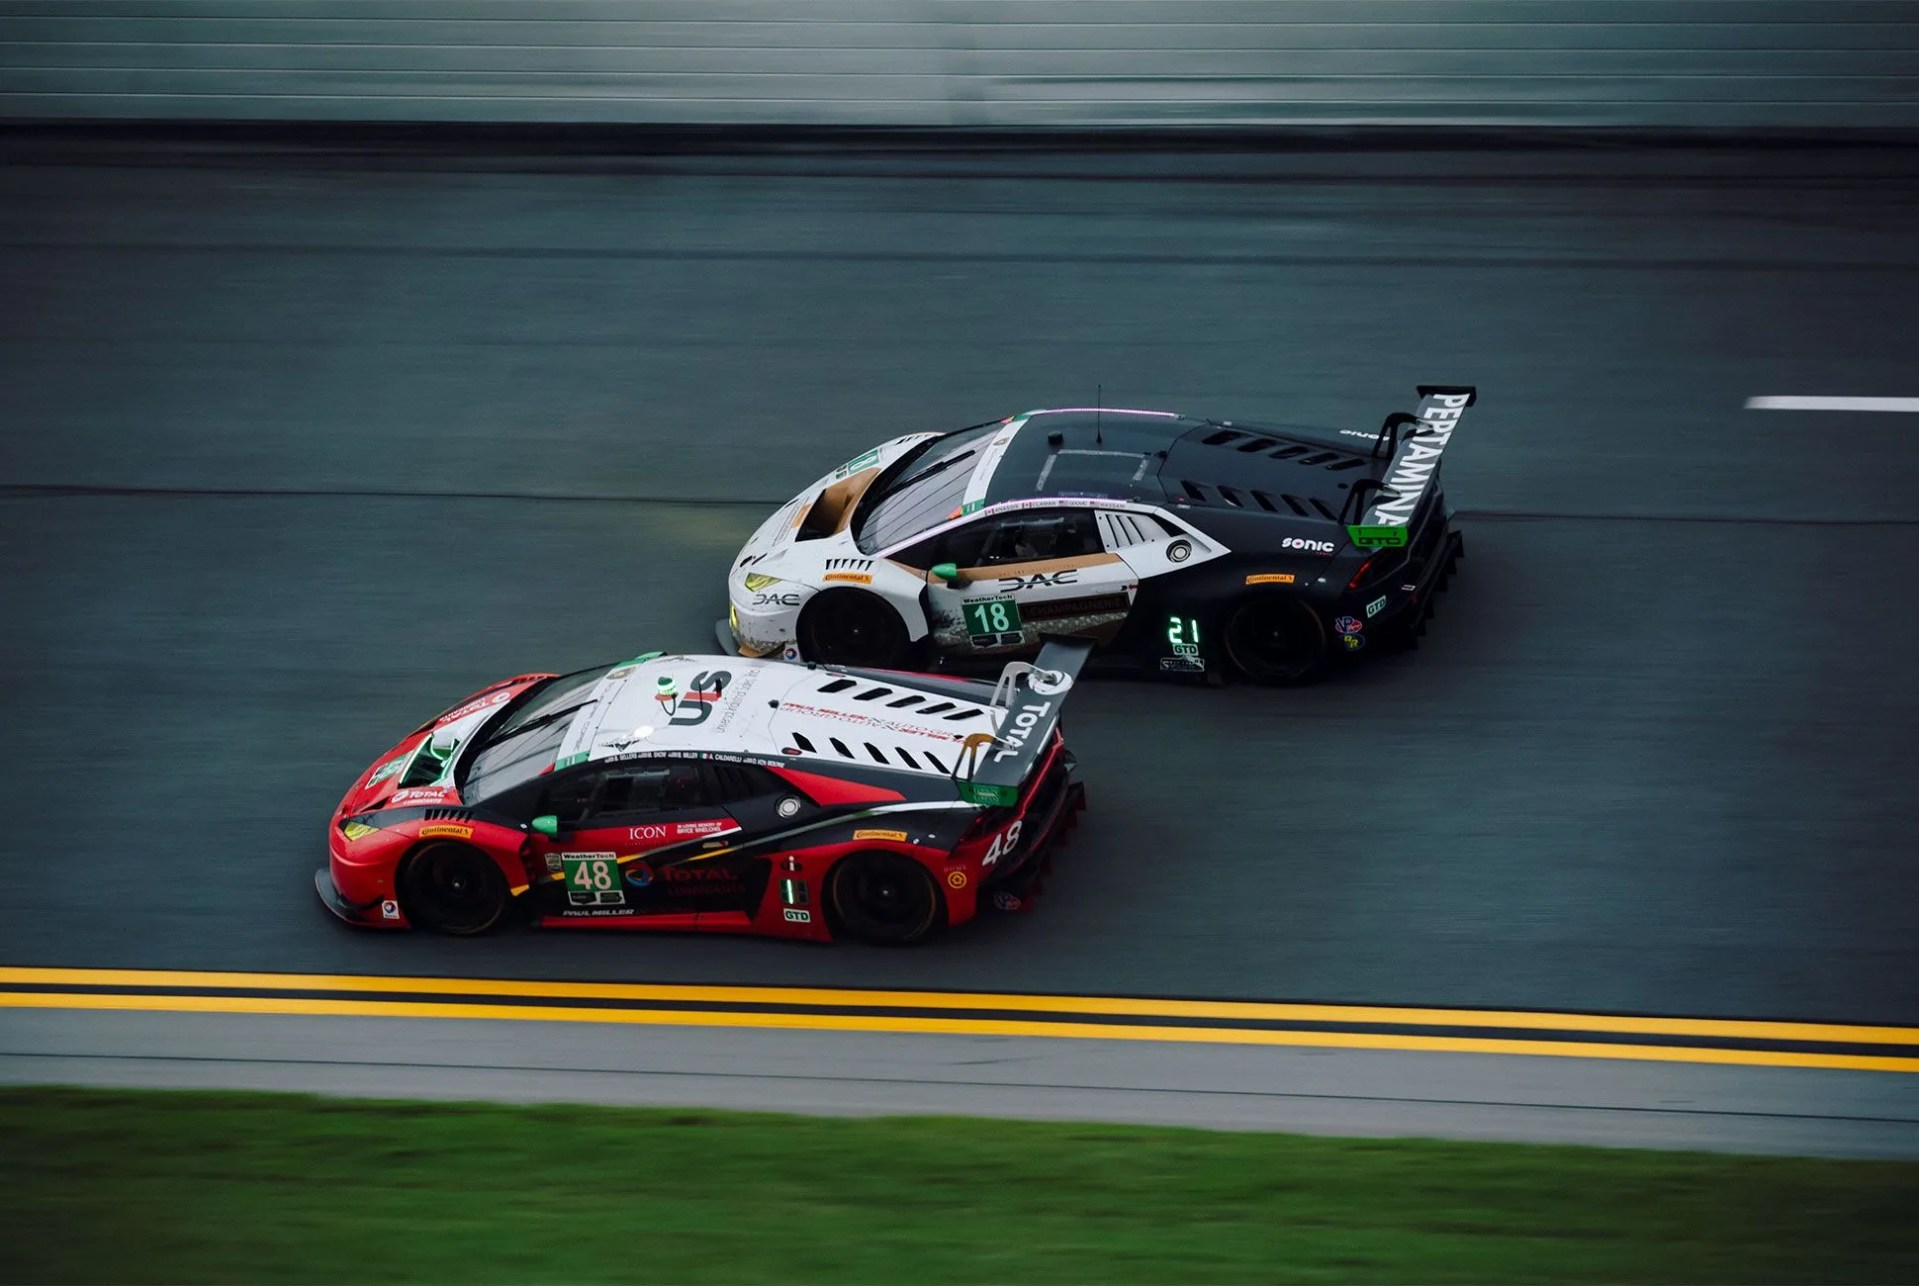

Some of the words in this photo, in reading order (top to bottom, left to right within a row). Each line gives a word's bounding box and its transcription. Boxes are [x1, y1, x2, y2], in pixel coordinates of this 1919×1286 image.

[825, 573, 864, 581] Continental
[998, 568, 1079, 593] DAC
[963, 594, 1014, 603] WeatherTech
[1367, 598, 1387, 615] GTD
[974, 602, 1009, 633] 18
[1169, 616, 1199, 644] 21
[1174, 645, 1197, 654] GTD
[994, 702, 1051, 762] TOTAL
[409, 790, 446, 799] TOTAL
[421, 827, 463, 836] Continental
[629, 826, 667, 840] ICON
[982, 820, 1023, 867] 48
[563, 852, 615, 860] WeatherTech
[574, 861, 612, 890] 48
[562, 909, 591, 917] PAUL
[591, 908, 635, 917] MILLER
[785, 910, 809, 921] GTD
